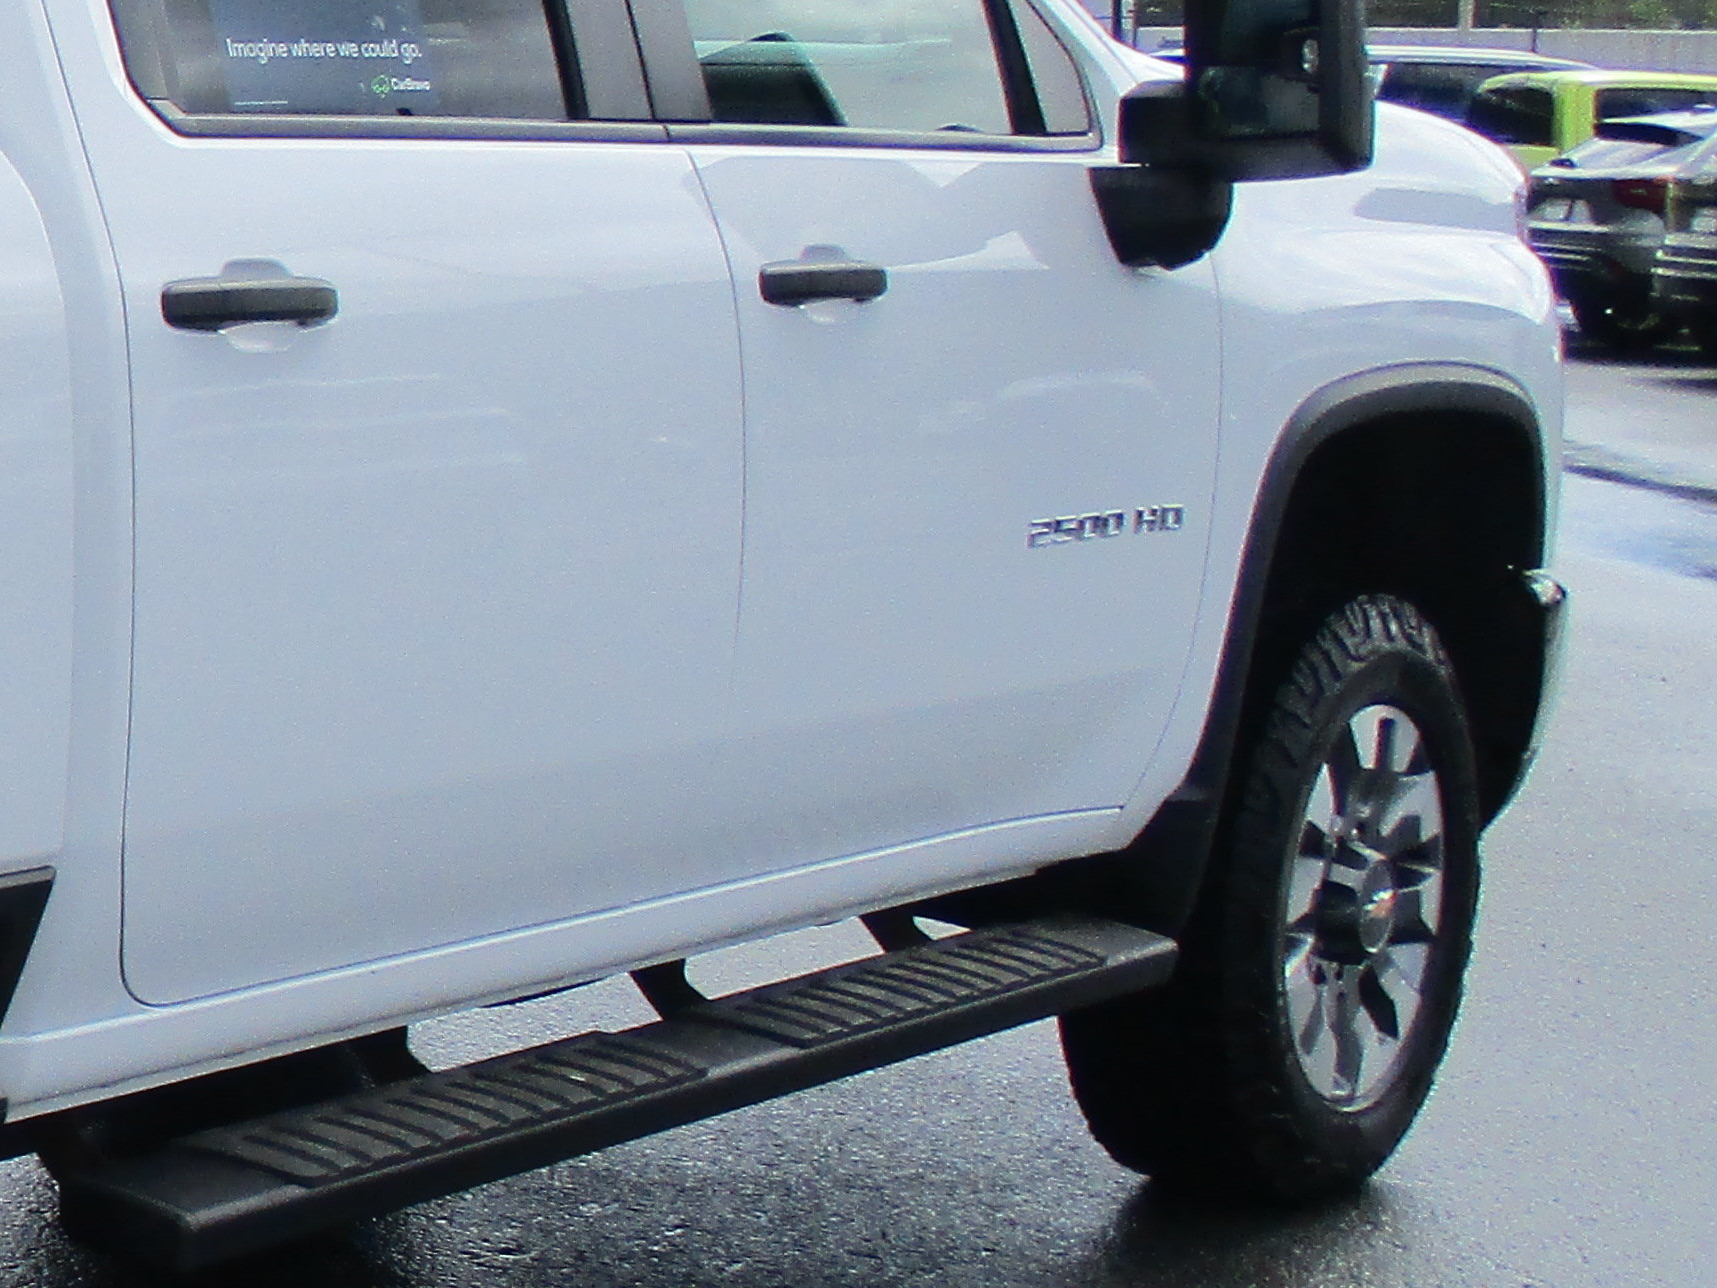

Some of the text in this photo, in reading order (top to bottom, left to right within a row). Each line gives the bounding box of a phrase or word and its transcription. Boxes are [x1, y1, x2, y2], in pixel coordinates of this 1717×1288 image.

[226, 38, 423, 64] Imagine where we could go.
[1026, 503, 1187, 548] 2500 HD
